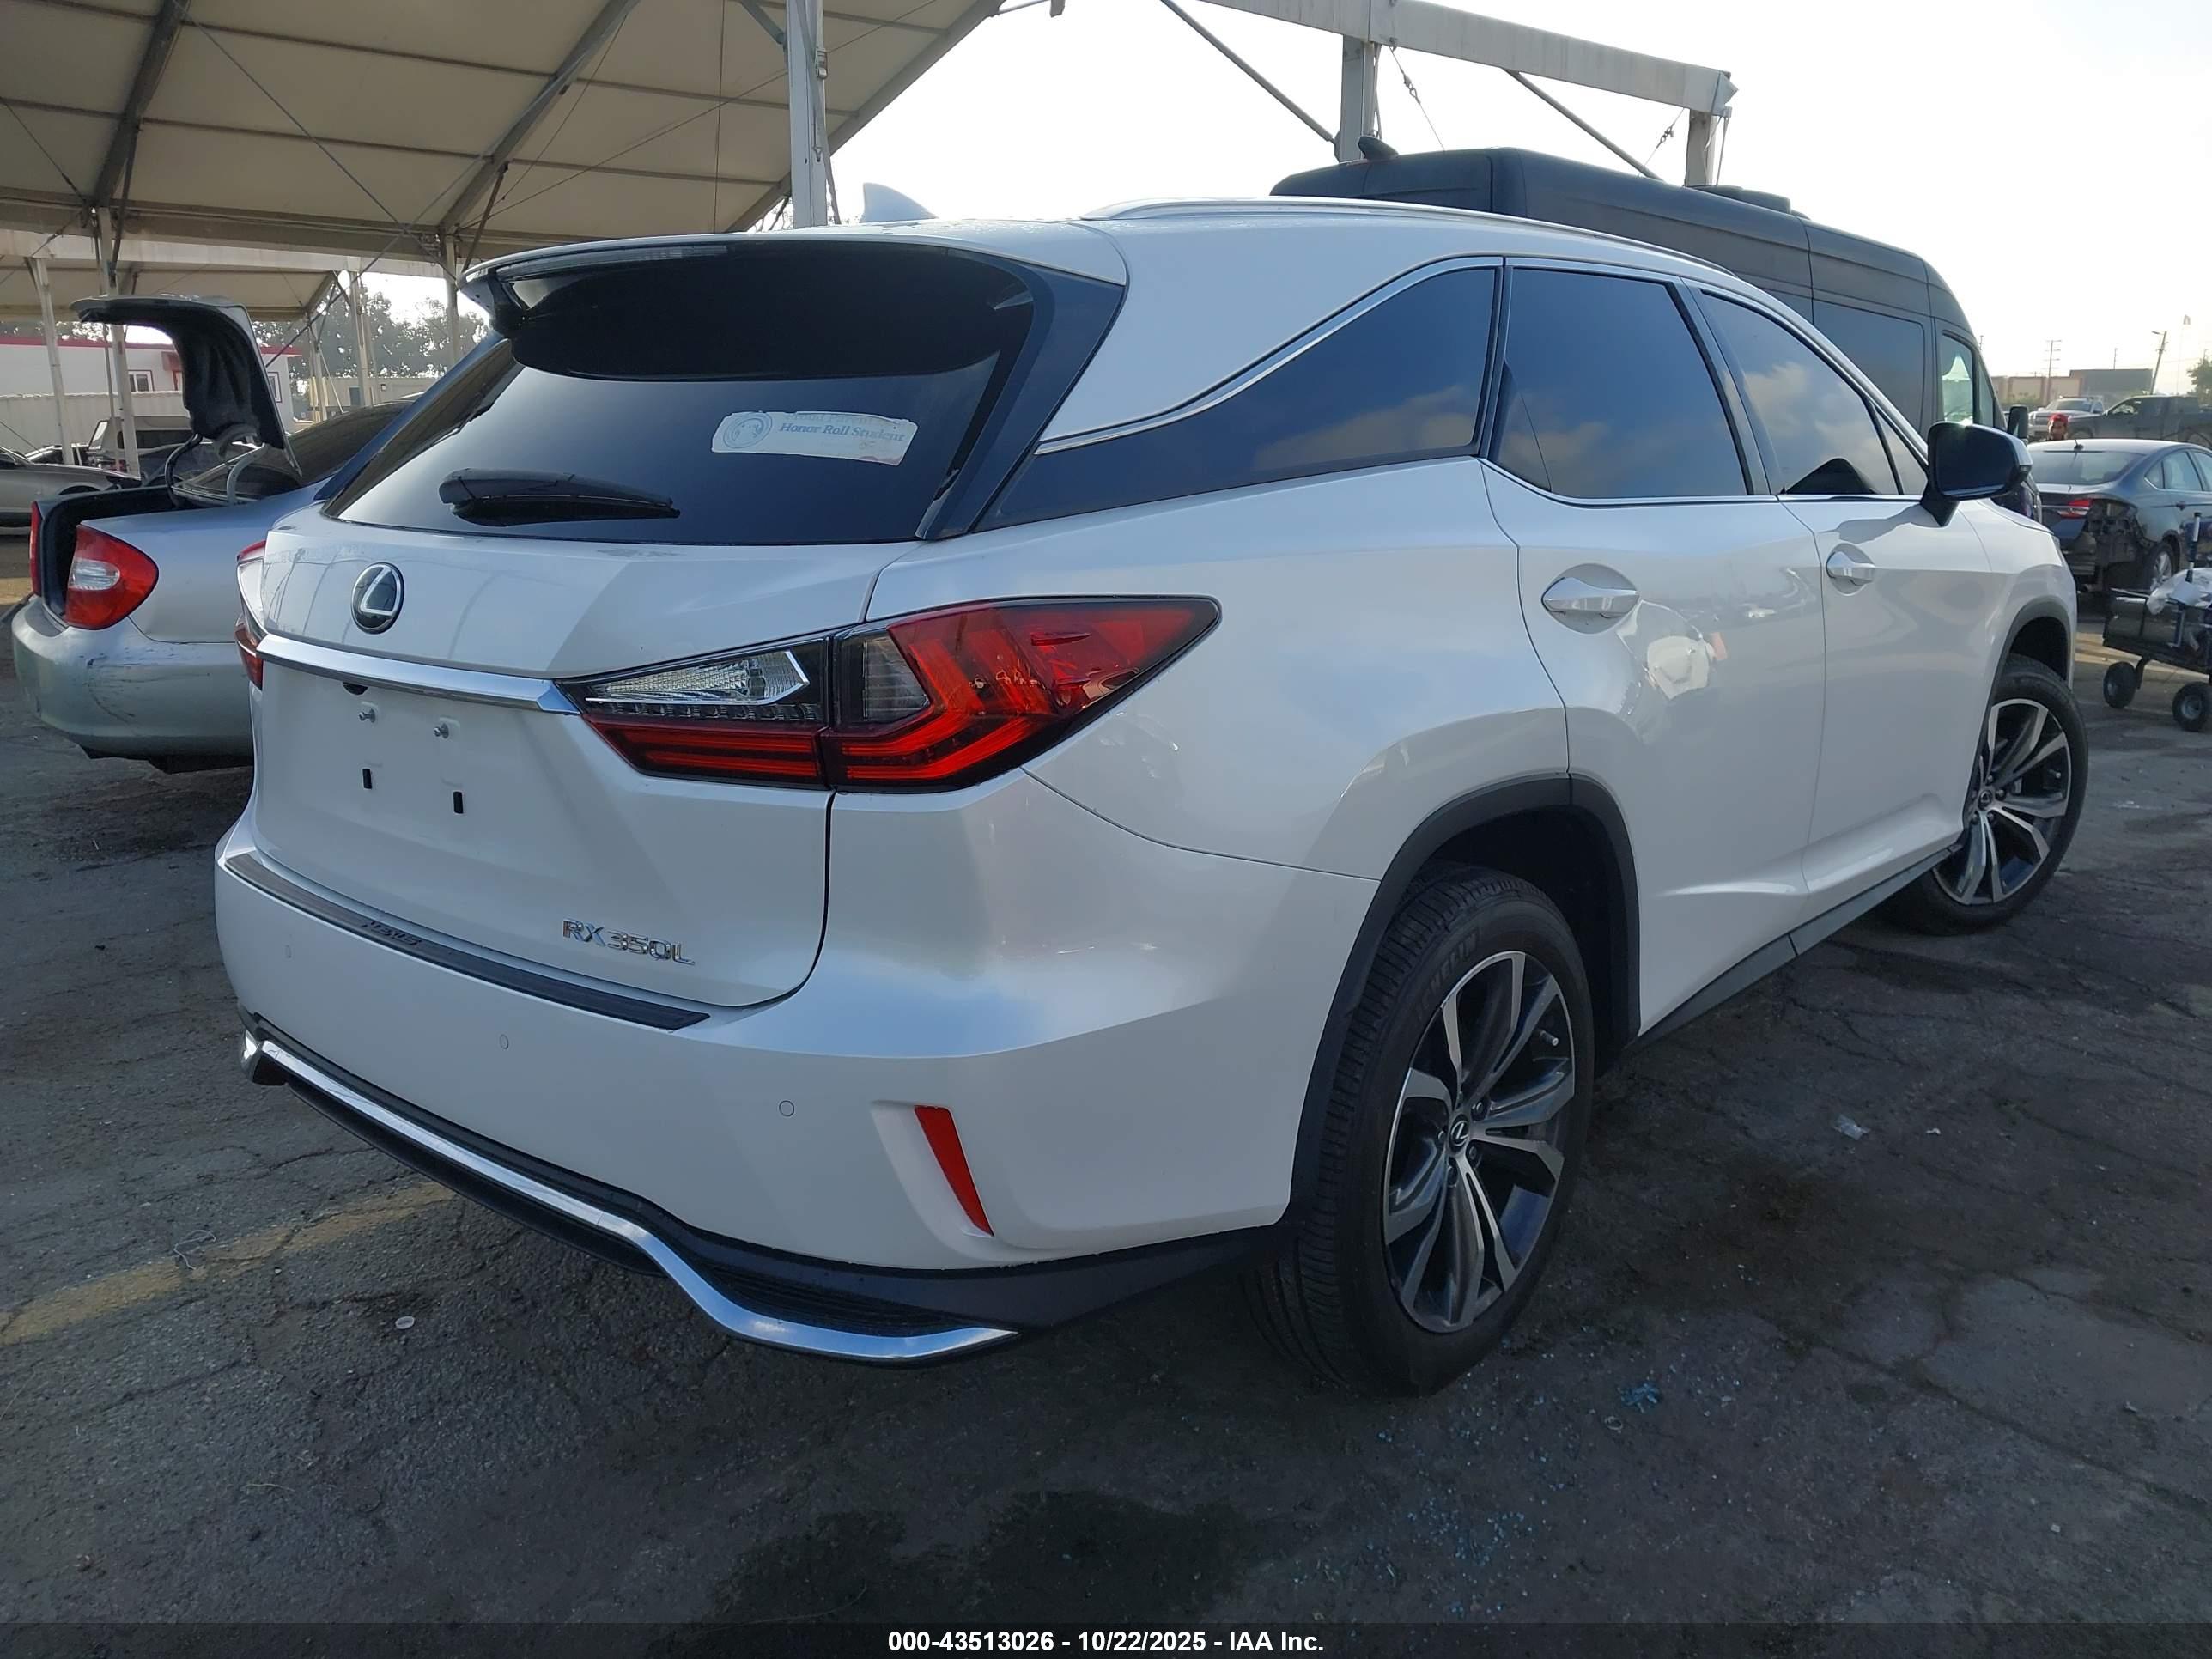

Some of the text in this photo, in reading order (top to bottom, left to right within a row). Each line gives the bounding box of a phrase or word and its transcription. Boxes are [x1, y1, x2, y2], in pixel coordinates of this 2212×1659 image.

[779, 422, 905, 441] Honor Roll Student
